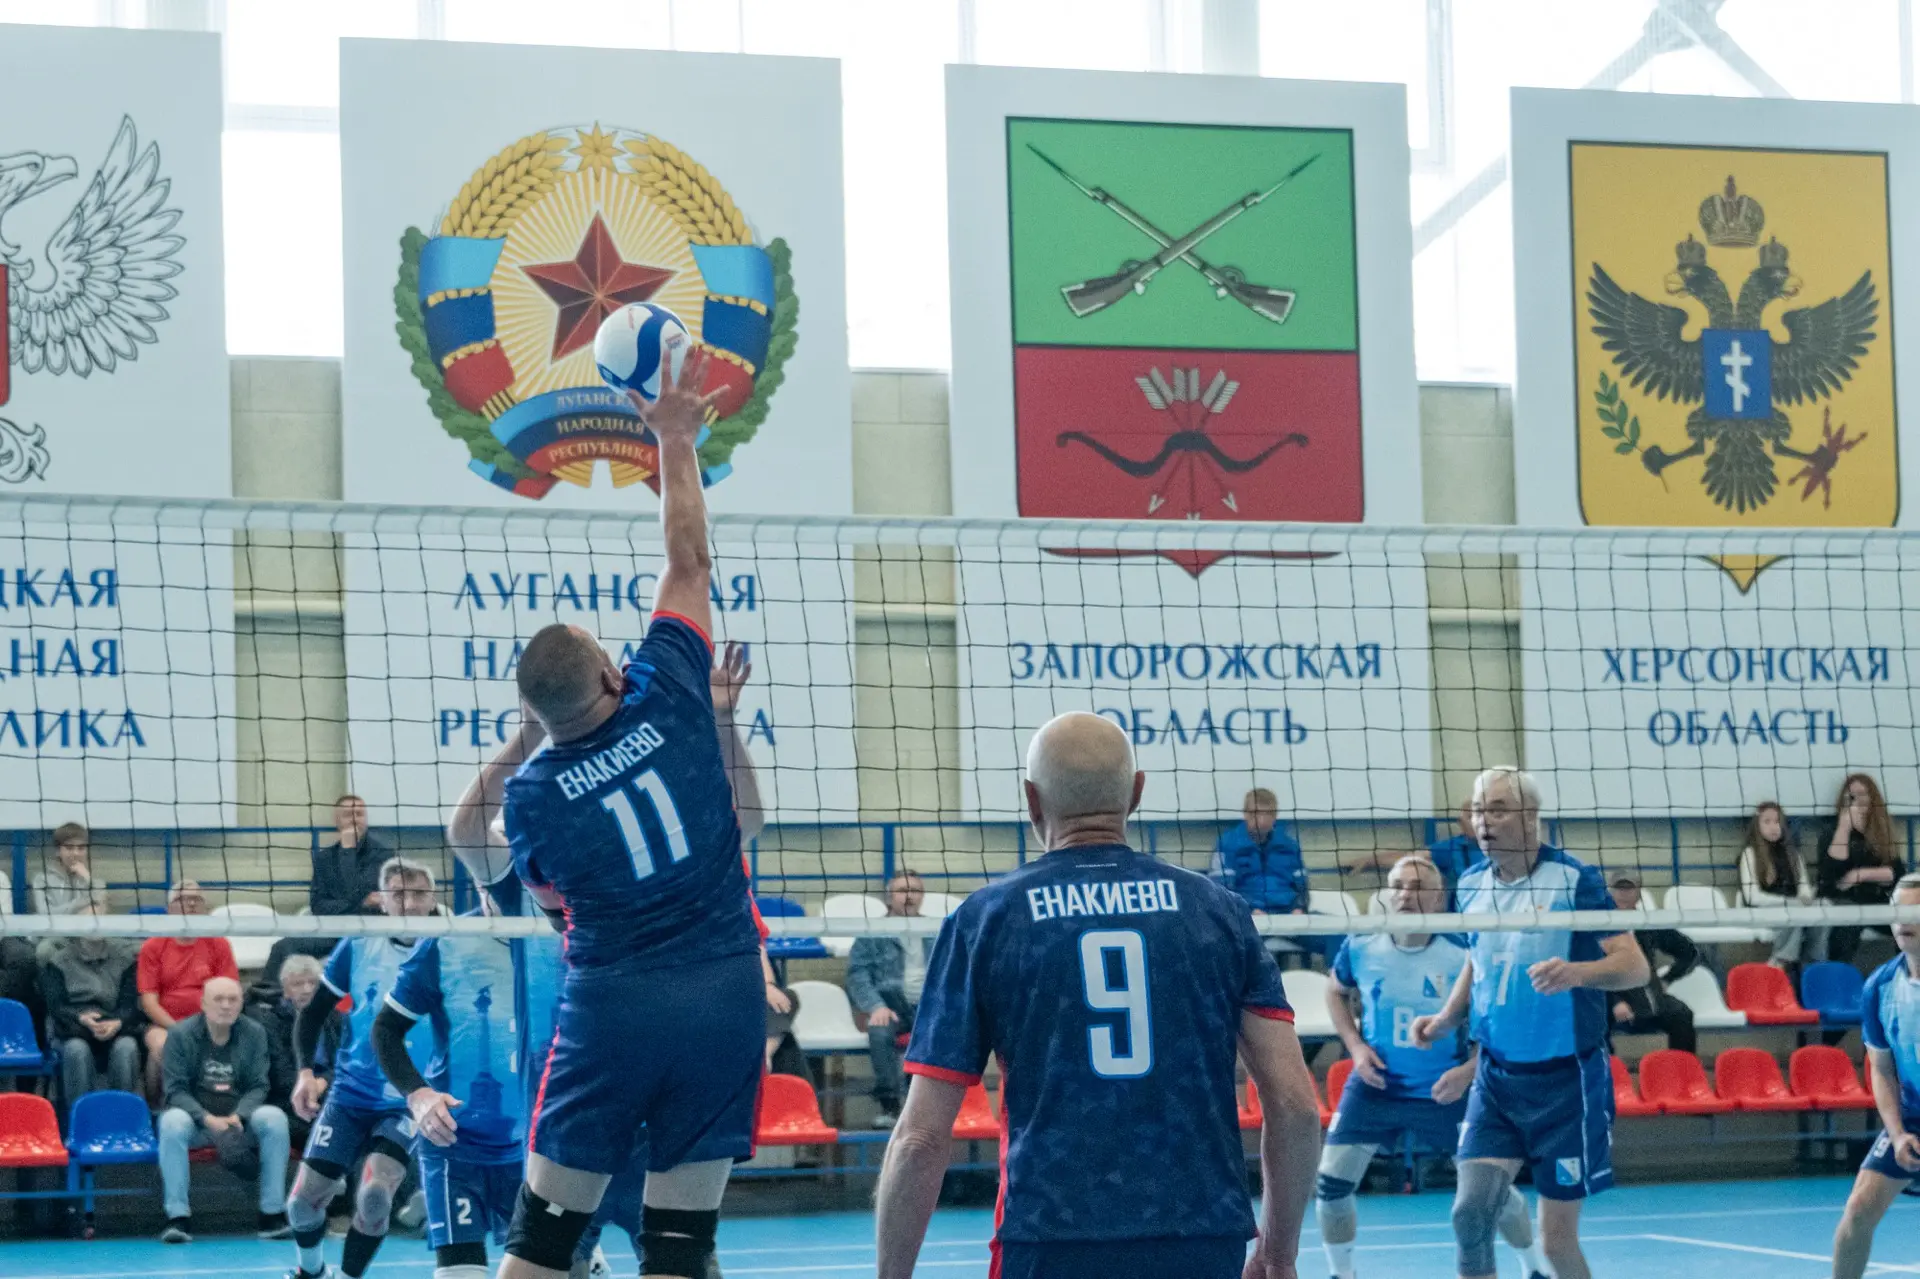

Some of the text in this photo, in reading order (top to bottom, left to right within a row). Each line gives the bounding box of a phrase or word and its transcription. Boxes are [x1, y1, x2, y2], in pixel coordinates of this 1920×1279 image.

[557, 416, 645, 435] НАРОДНАЯ
[549, 441, 653, 465] РЕСПУБЛИКА
[454, 573, 757, 613] ЛУГАНСЯ
[0, 638, 119, 681] НАЯ
[1010, 642, 1382, 680] ЗАПОРОЖСКАЯ
[1602, 647, 1890, 683] ХЕРСОНСКАЯ
[1648, 709, 1849, 746] ОБЛАСТЬ
[555, 722, 666, 801] ЕНАКИЕВО
[601, 766, 693, 883] 11
[1027, 879, 1179, 923] ЕНАКИЕВО
[1492, 952, 1514, 1006] 7
[1079, 929, 1154, 1079] 9
[315, 1124, 333, 1147] 12
[456, 1198, 472, 1224] 2
